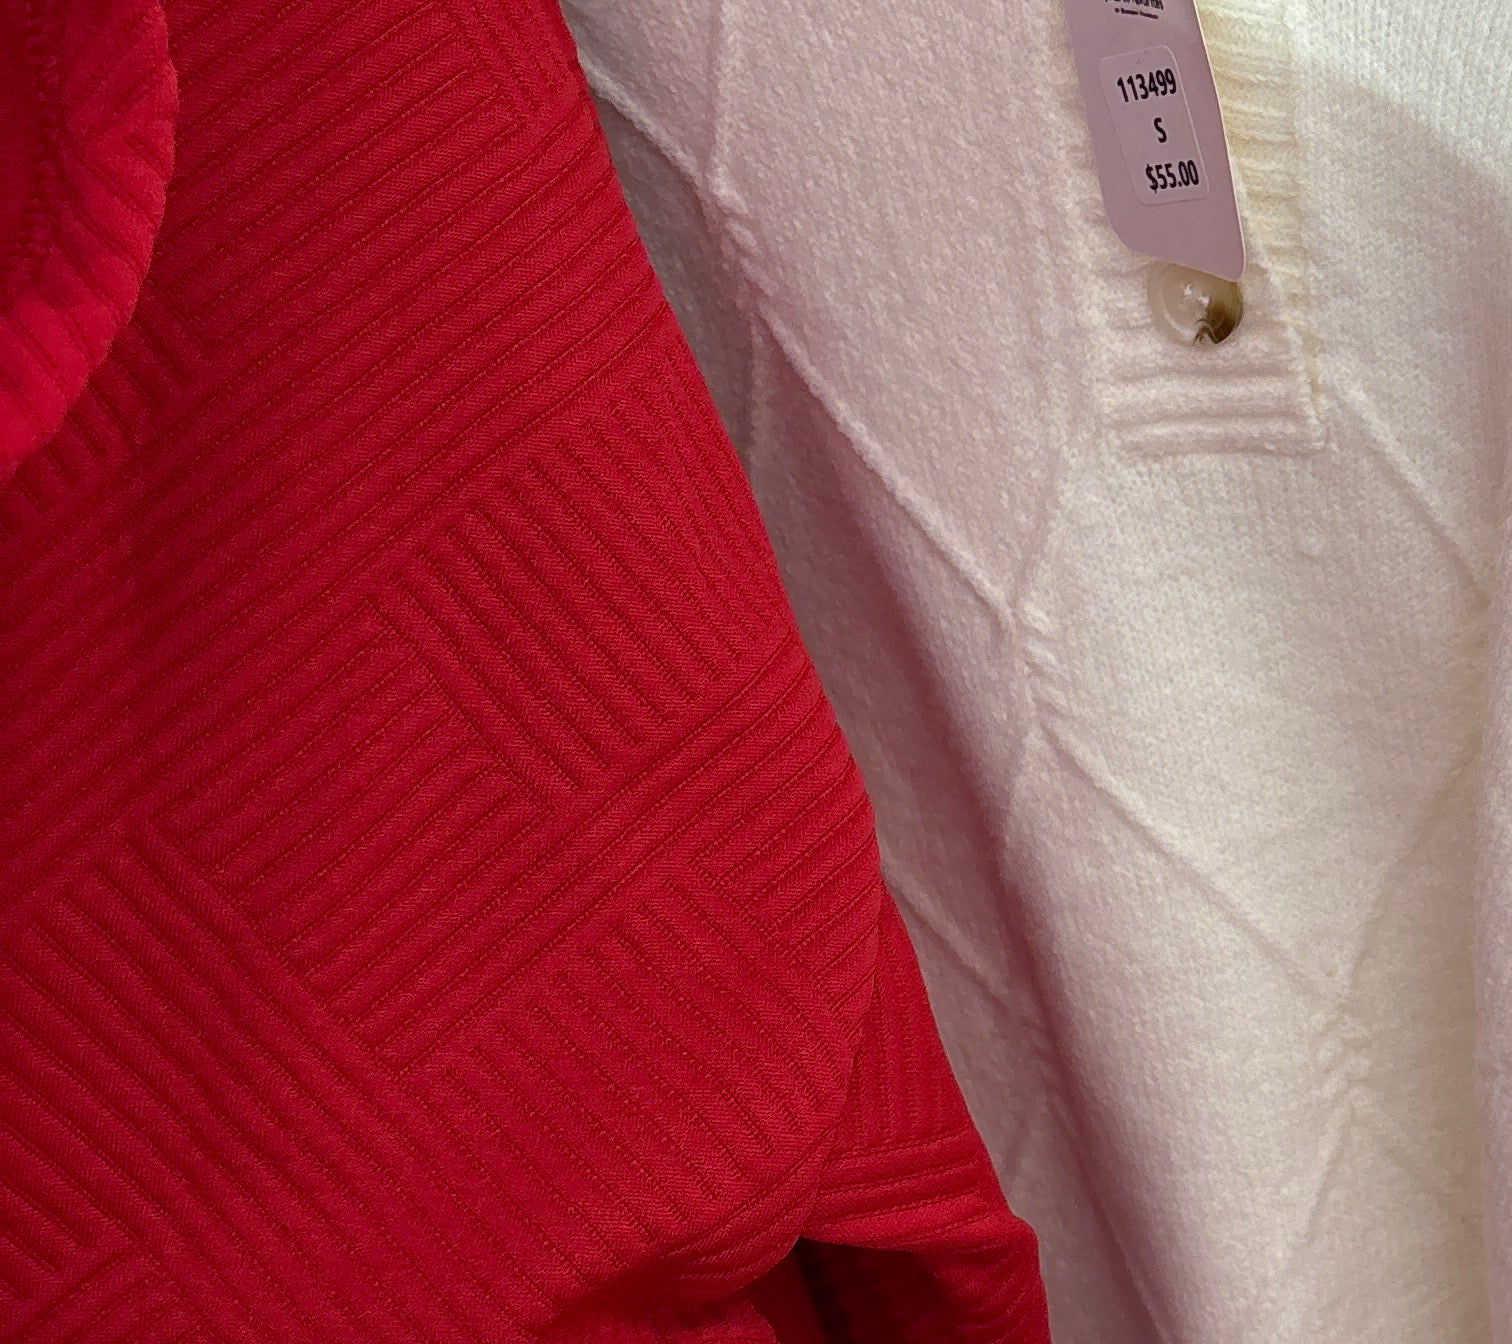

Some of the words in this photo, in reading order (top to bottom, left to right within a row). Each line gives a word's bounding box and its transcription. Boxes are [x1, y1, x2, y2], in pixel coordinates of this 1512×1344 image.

[1117, 68, 1177, 102] 113499
[1153, 117, 1167, 143] S
[1145, 159, 1199, 193] $55.00
